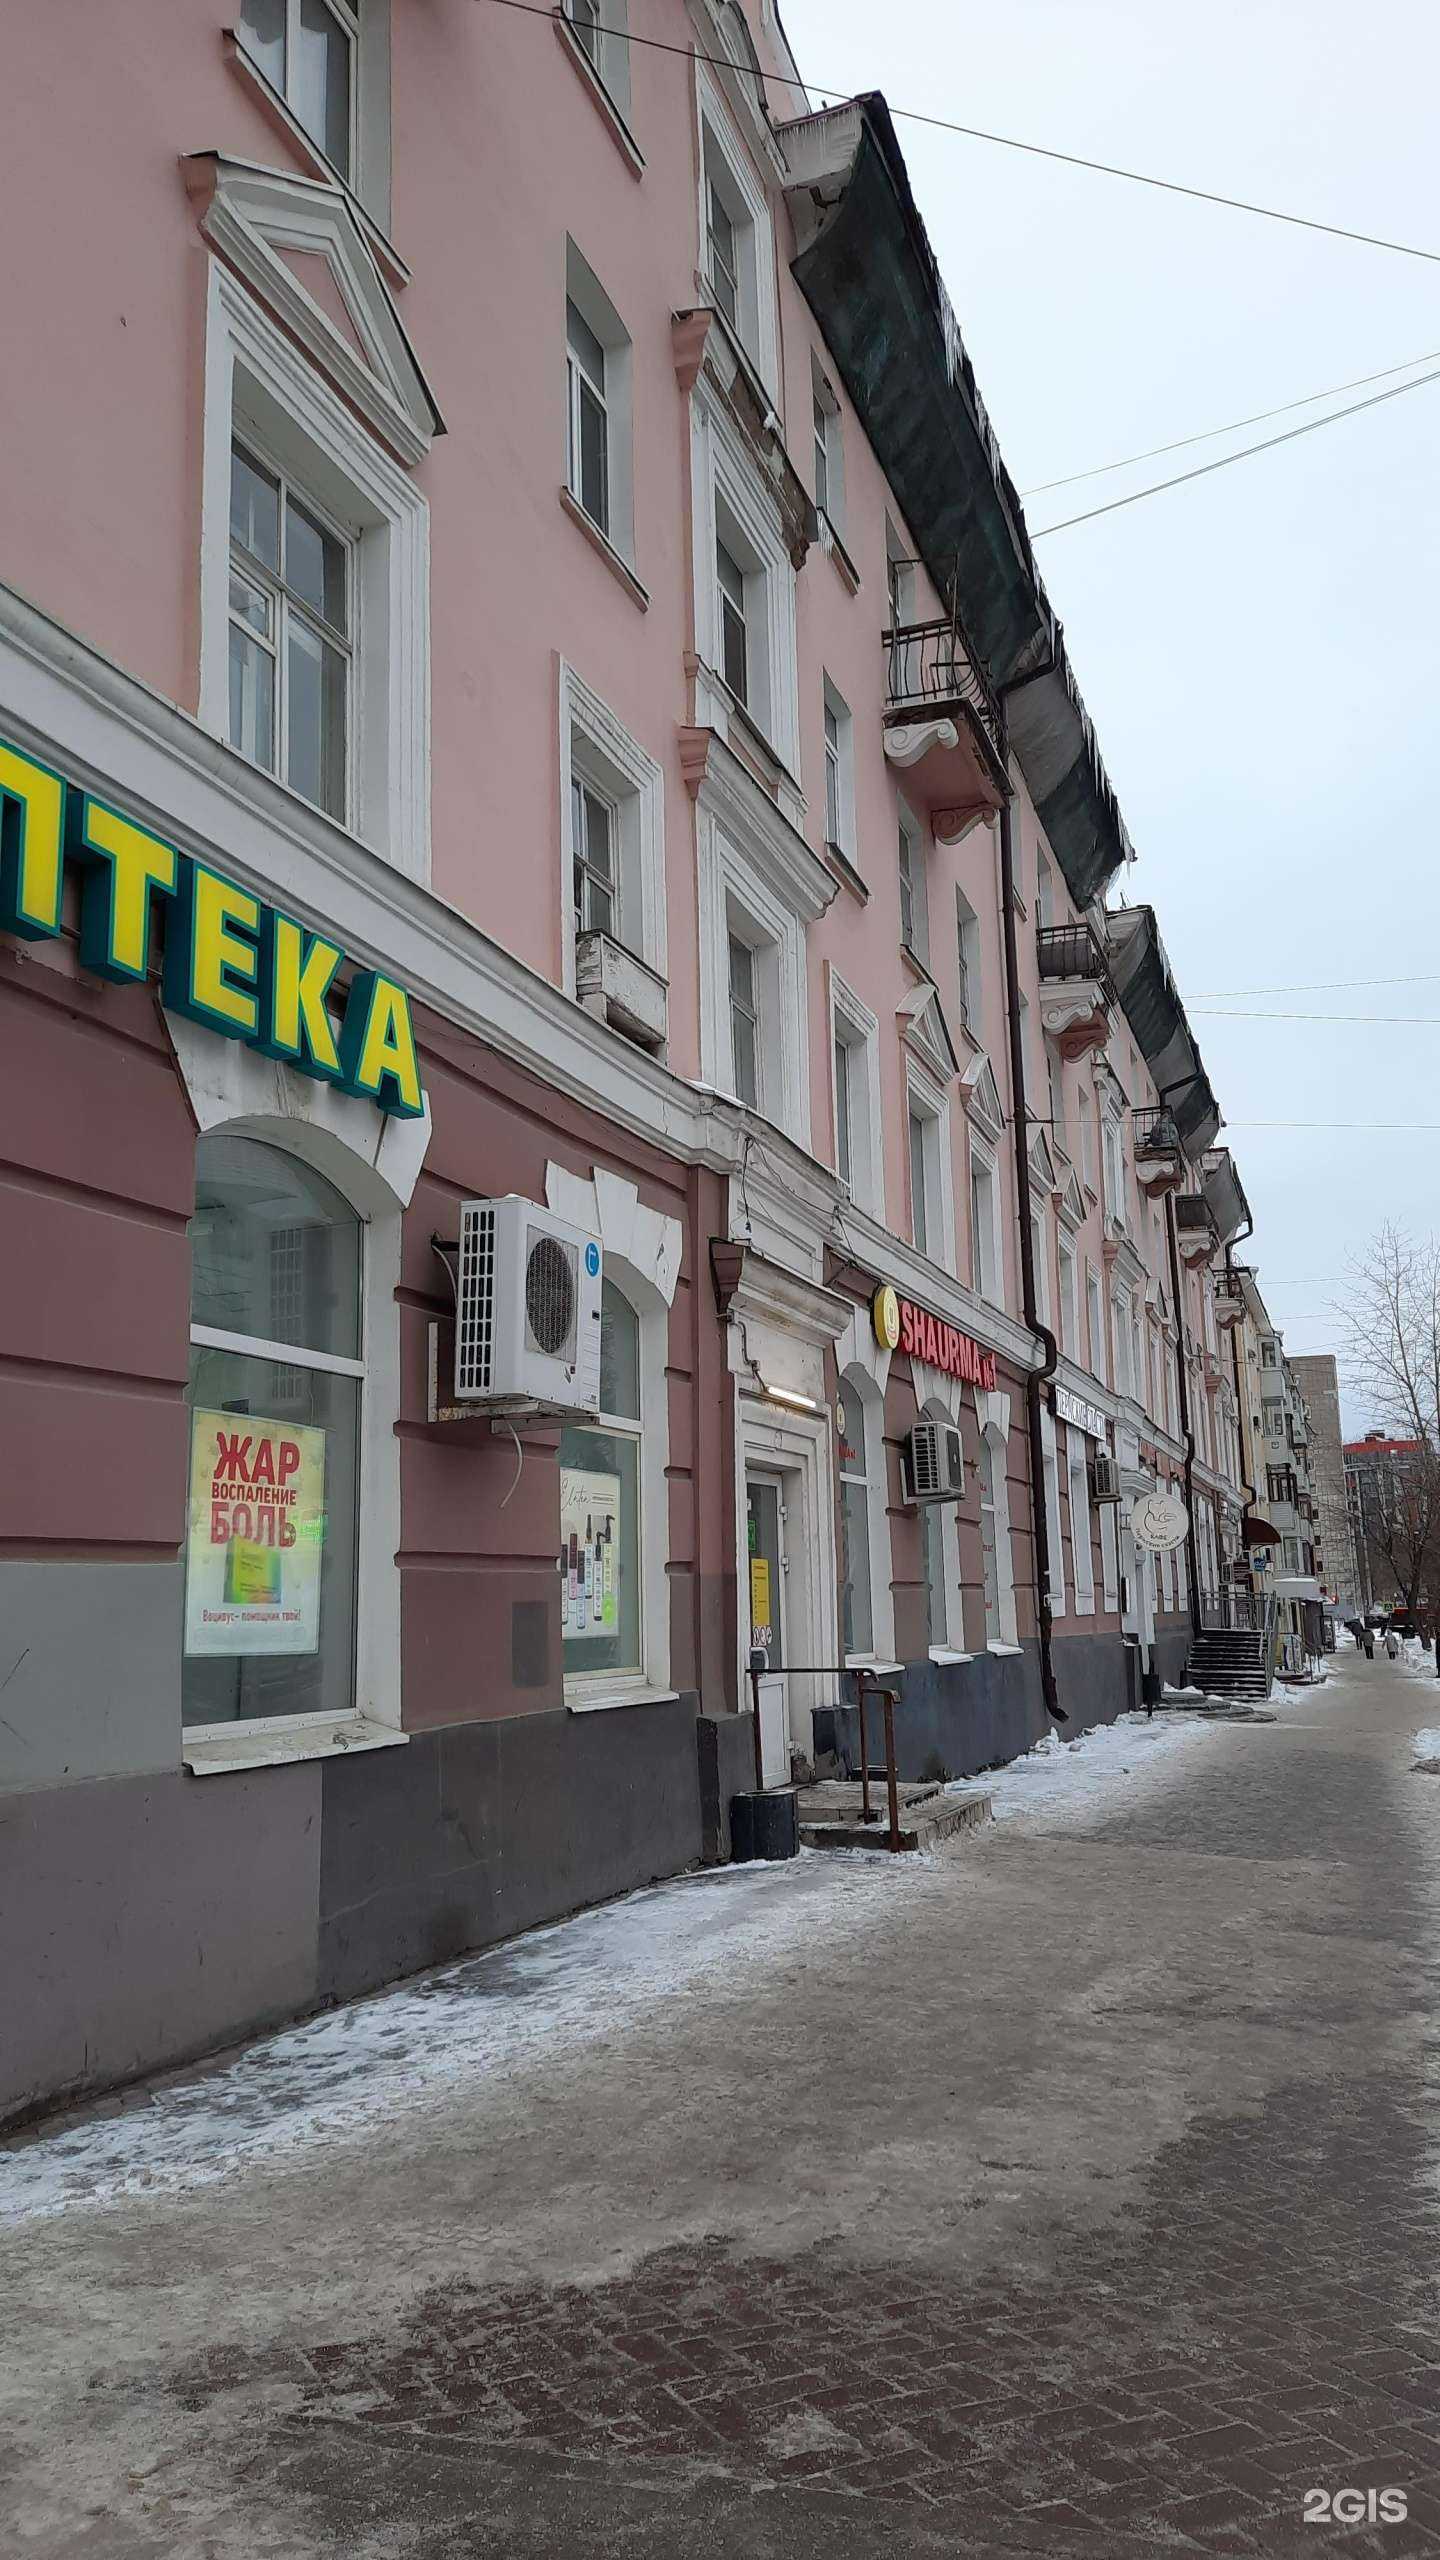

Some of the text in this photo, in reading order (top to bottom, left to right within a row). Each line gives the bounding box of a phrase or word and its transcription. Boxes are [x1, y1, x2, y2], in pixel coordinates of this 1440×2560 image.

[901, 1300, 982, 1388] SHAURMA
[213, 1431, 301, 1487] ЖАР
[211, 1481, 297, 1506] ВОСПАЛЕНИЕ
[210, 1501, 297, 1548] БОЛЬ
